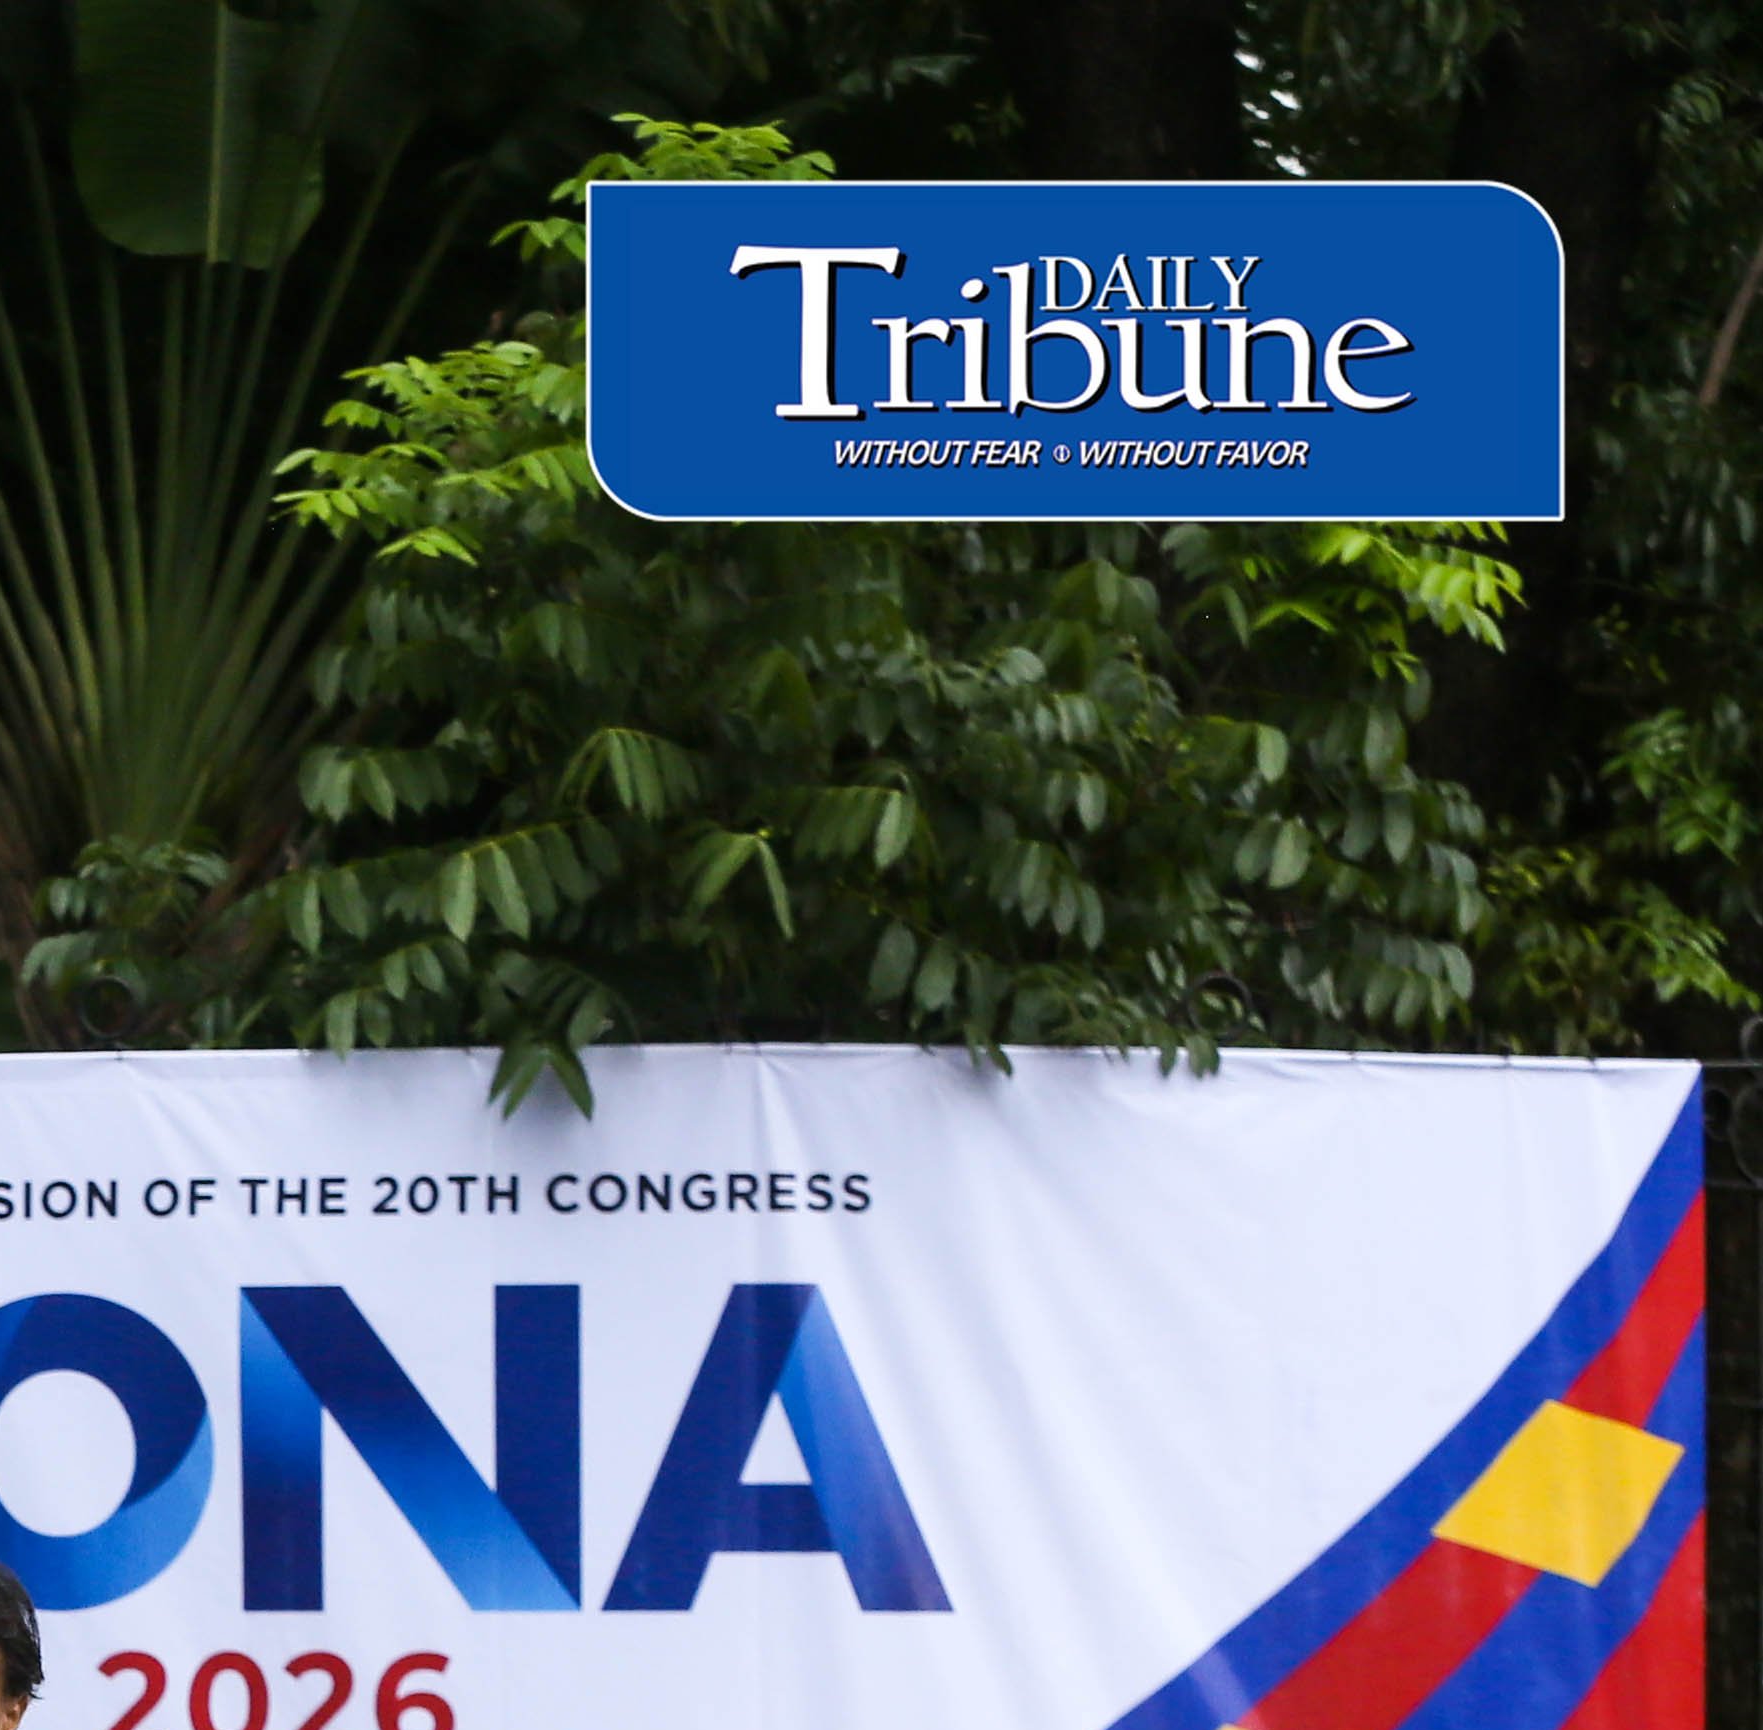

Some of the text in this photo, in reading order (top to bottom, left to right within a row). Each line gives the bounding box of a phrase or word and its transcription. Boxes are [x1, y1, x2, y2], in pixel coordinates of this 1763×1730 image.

[143, 1178, 217, 1218] OF
[239, 1177, 347, 1216] THE
[372, 1174, 520, 1215] 20TH
[545, 1172, 871, 1215] CONGRESS
